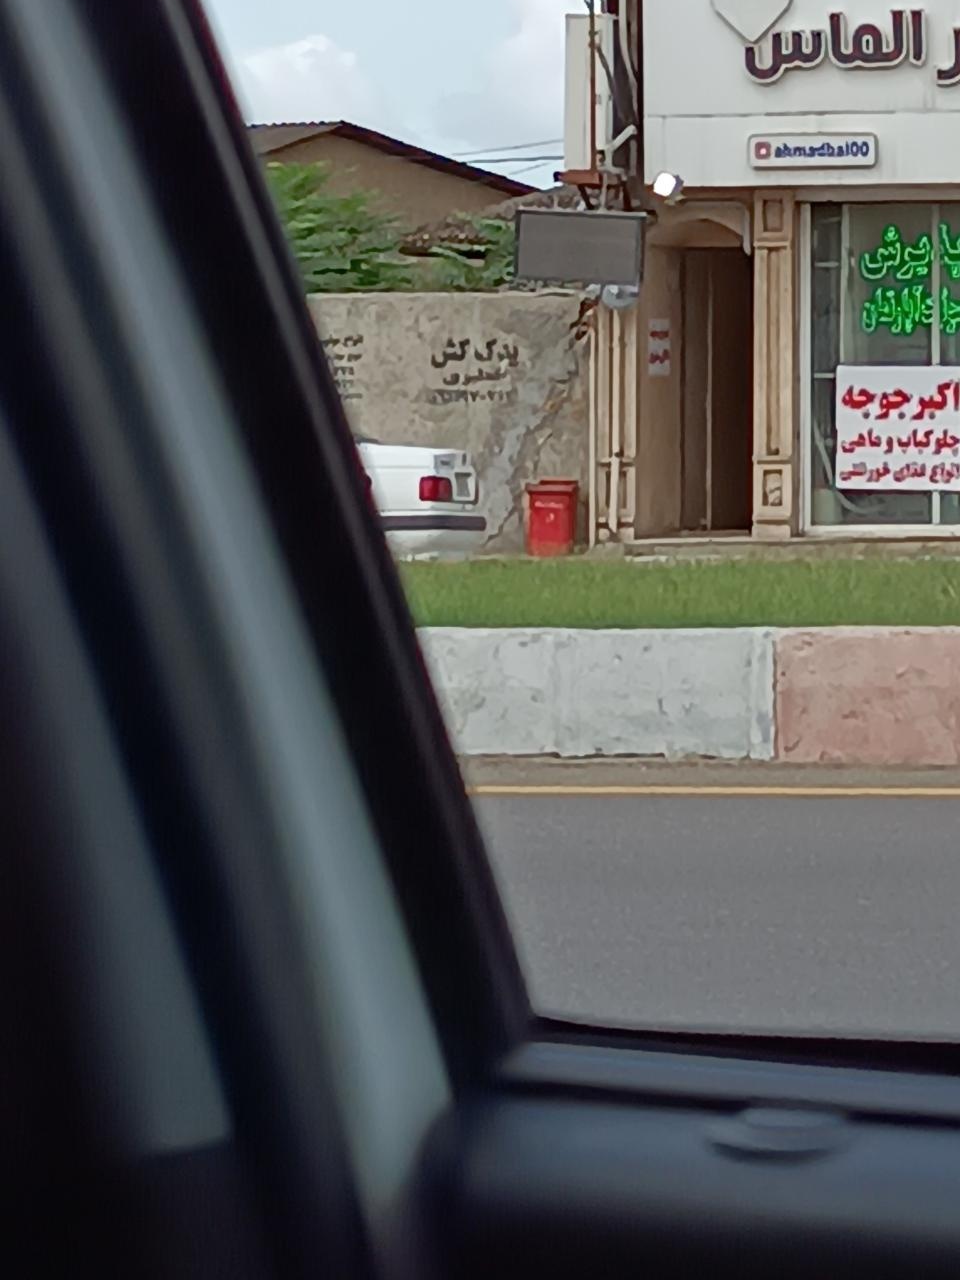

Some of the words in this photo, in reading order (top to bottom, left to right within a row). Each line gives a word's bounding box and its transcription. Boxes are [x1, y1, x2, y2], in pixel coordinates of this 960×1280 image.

[744, 7, 927, 85] الماس
[841, 384, 912, 420] جوجه
[911, 379, 960, 420] اکبر
[840, 428, 882, 454] ماهی
